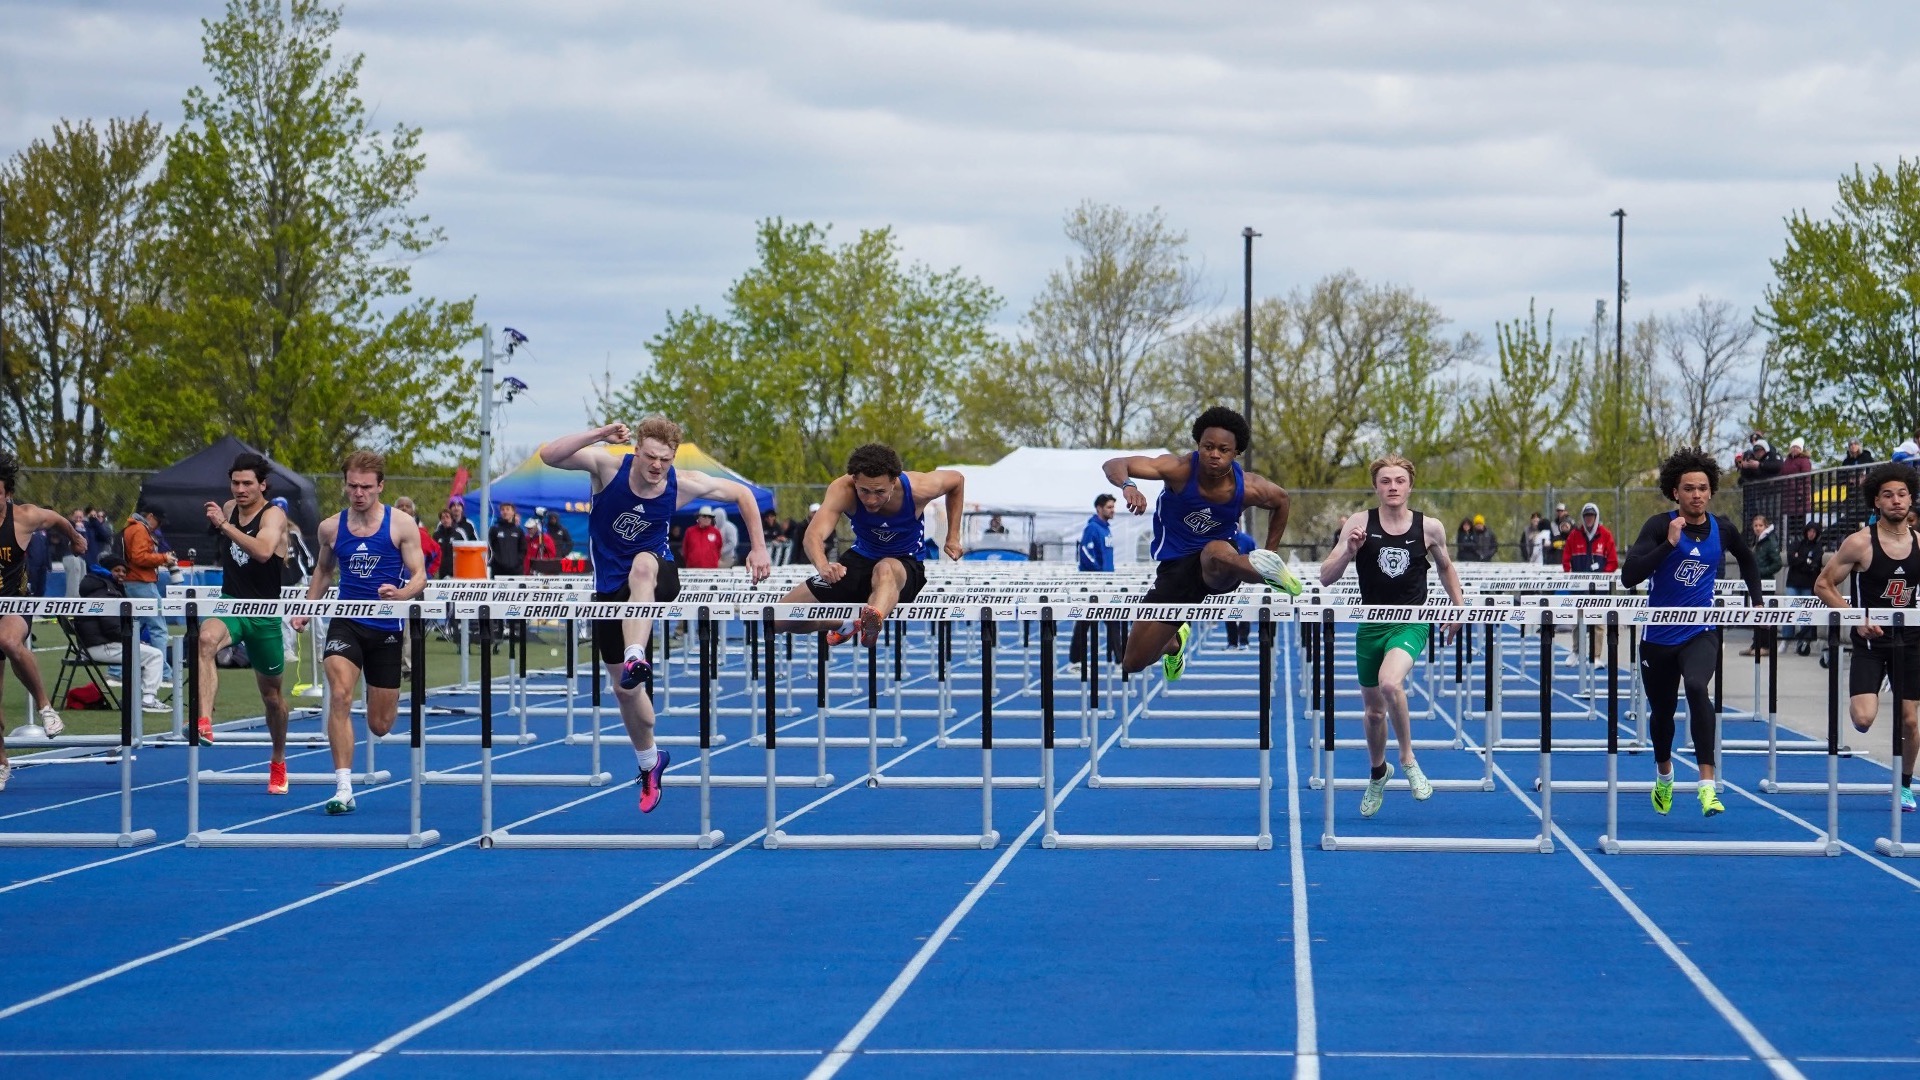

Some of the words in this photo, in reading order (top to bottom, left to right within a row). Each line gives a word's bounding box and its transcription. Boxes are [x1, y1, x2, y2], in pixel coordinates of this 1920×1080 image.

[612, 512, 652, 541] GV
[349, 552, 381, 578] GV
[1674, 559, 1710, 587] GV
[279, 590, 301, 599] LEY
[451, 592, 488, 601] GRAND
[492, 592, 529, 602] VALLEY
[532, 592, 565, 602] STATE
[678, 594, 714, 603] GRAND
[717, 594, 755, 603] VALLEY
[757, 594, 785, 603] STAT
[1205, 596, 1236, 604] STATE
[0, 602, 40, 614] ALLEY
[44, 602, 86, 614] STATE
[1576, 598, 1612, 608] GRAND
[1616, 598, 1648, 608] VALLE
[232, 603, 278, 615] GRAND
[284, 604, 332, 615] VALLEY
[334, 604, 376, 616] STATE
[524, 605, 570, 618] GRAND
[574, 606, 623, 618] VALLEY
[624, 606, 666, 618] STATE
[807, 607, 852, 619] GRAND
[907, 608, 949, 619] STATE
[1086, 608, 1130, 620] GRAND
[1136, 608, 1182, 620] VALLEY
[1186, 608, 1226, 620] STATE
[1367, 608, 1412, 620] GRAND
[1418, 609, 1464, 621] VALLEY
[1468, 610, 1508, 622] STATE
[1651, 611, 1698, 623] GRAND
[1701, 610, 1750, 623] VALLEY
[1754, 611, 1795, 623] STATE
